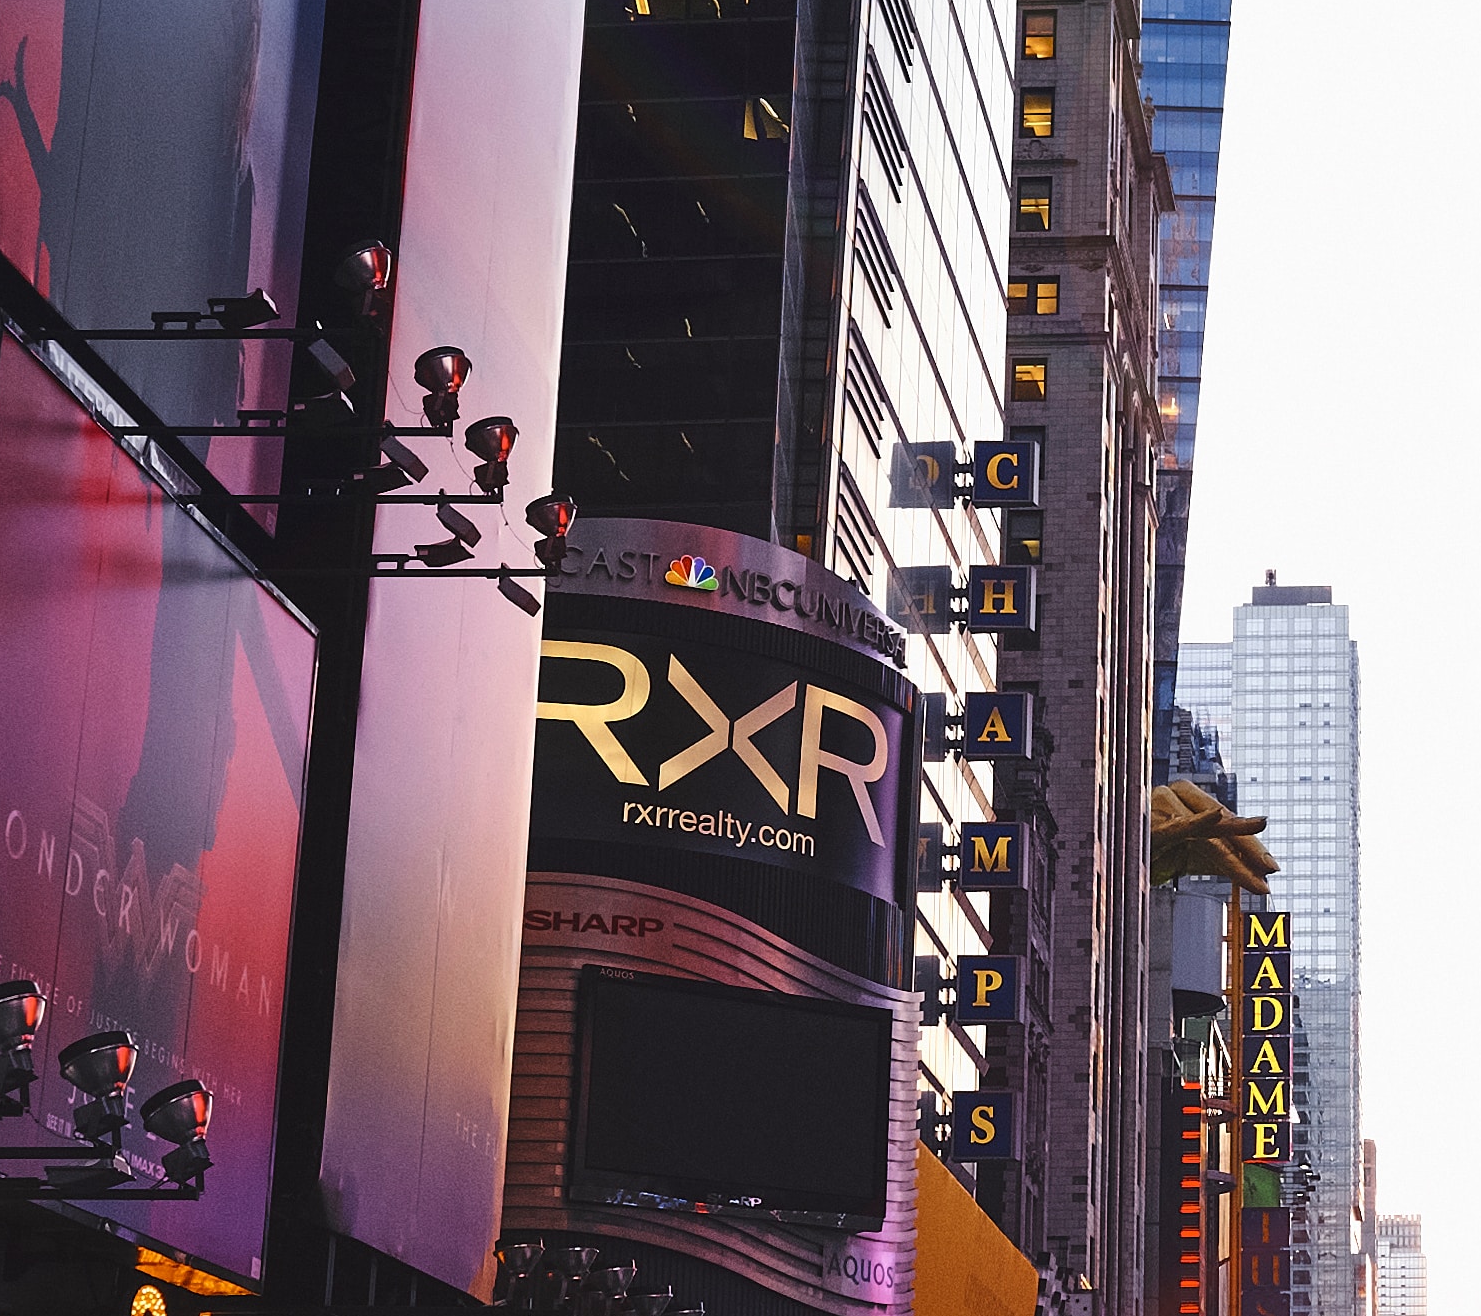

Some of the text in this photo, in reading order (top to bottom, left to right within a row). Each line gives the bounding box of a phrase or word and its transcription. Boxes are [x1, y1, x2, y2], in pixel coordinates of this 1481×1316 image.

[536, 639, 889, 849] RXR
[622, 799, 815, 858] rxrrealty.com
[970, 451, 1021, 1147] CHAMPS
[159, 907, 273, 1015] WOMAN
[523, 907, 664, 937] SHARP
[1247, 912, 1288, 1162] MADAME
[827, 1242, 895, 1289] AQUOS
